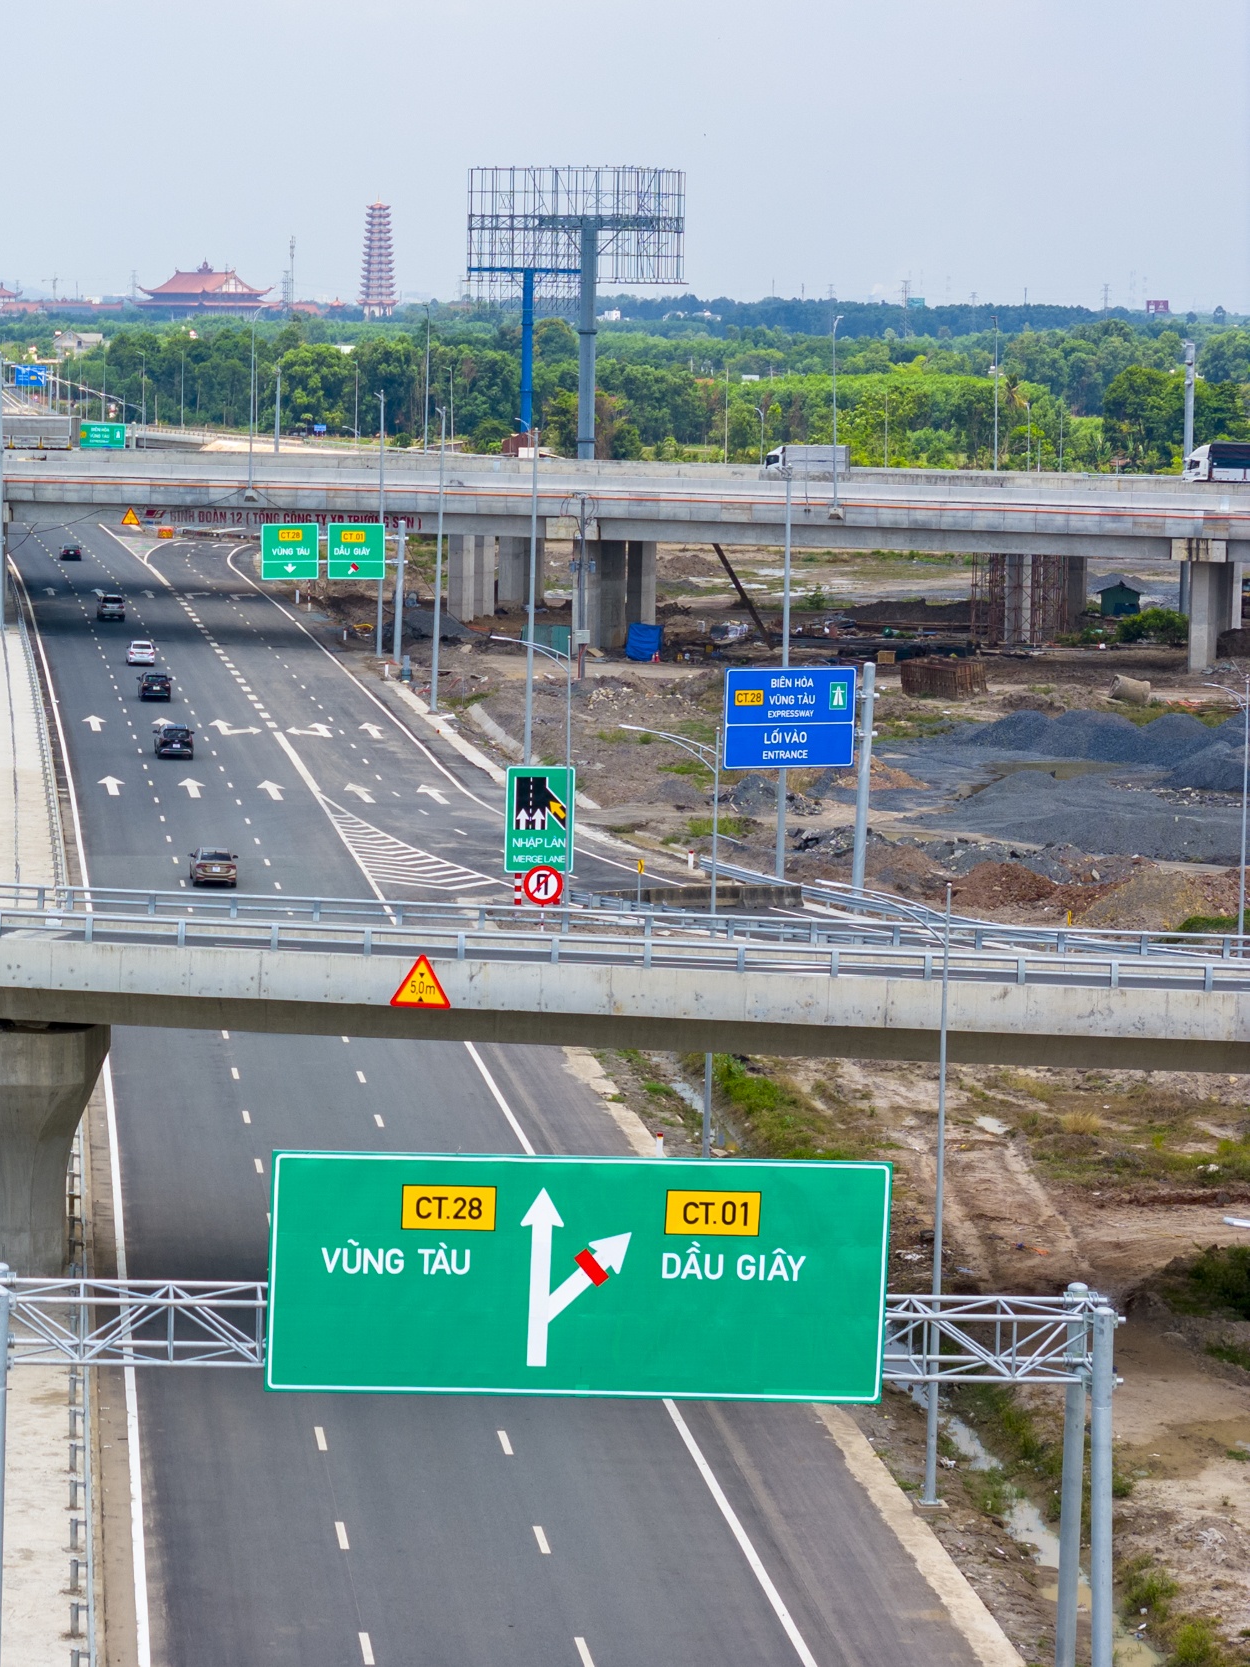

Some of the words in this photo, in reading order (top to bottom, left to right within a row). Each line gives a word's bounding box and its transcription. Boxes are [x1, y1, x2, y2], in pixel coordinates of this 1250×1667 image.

[170, 509, 195, 523] BINH
[198, 506, 227, 524] ĐOÀN
[230, 512, 243, 524] 12
[283, 511, 312, 524] CÔNG
[315, 514, 327, 526] TY
[770, 675, 792, 688] BIÊN
[794, 676, 814, 688] HÒA
[736, 692, 762, 704] CT.28
[769, 693, 795, 705] VŨNG
[797, 693, 816, 705] TÀU
[767, 709, 815, 719] EXPRESSWAY
[763, 727, 782, 745] LỐI
[784, 729, 808, 744] VÀO
[762, 750, 808, 760] ENTRANCE
[512, 836, 543, 849] NHẬP
[544, 835, 566, 848] LÀN
[512, 855, 543, 864] MERGE
[543, 855, 566, 864] LANE
[415, 1196, 483, 1220] CT.28
[682, 1200, 749, 1227] CT.01
[321, 1238, 405, 1275] VŨNG
[417, 1242, 471, 1275] TÀU
[661, 1240, 724, 1280] DẦU
[736, 1247, 807, 1282] GIÂY
